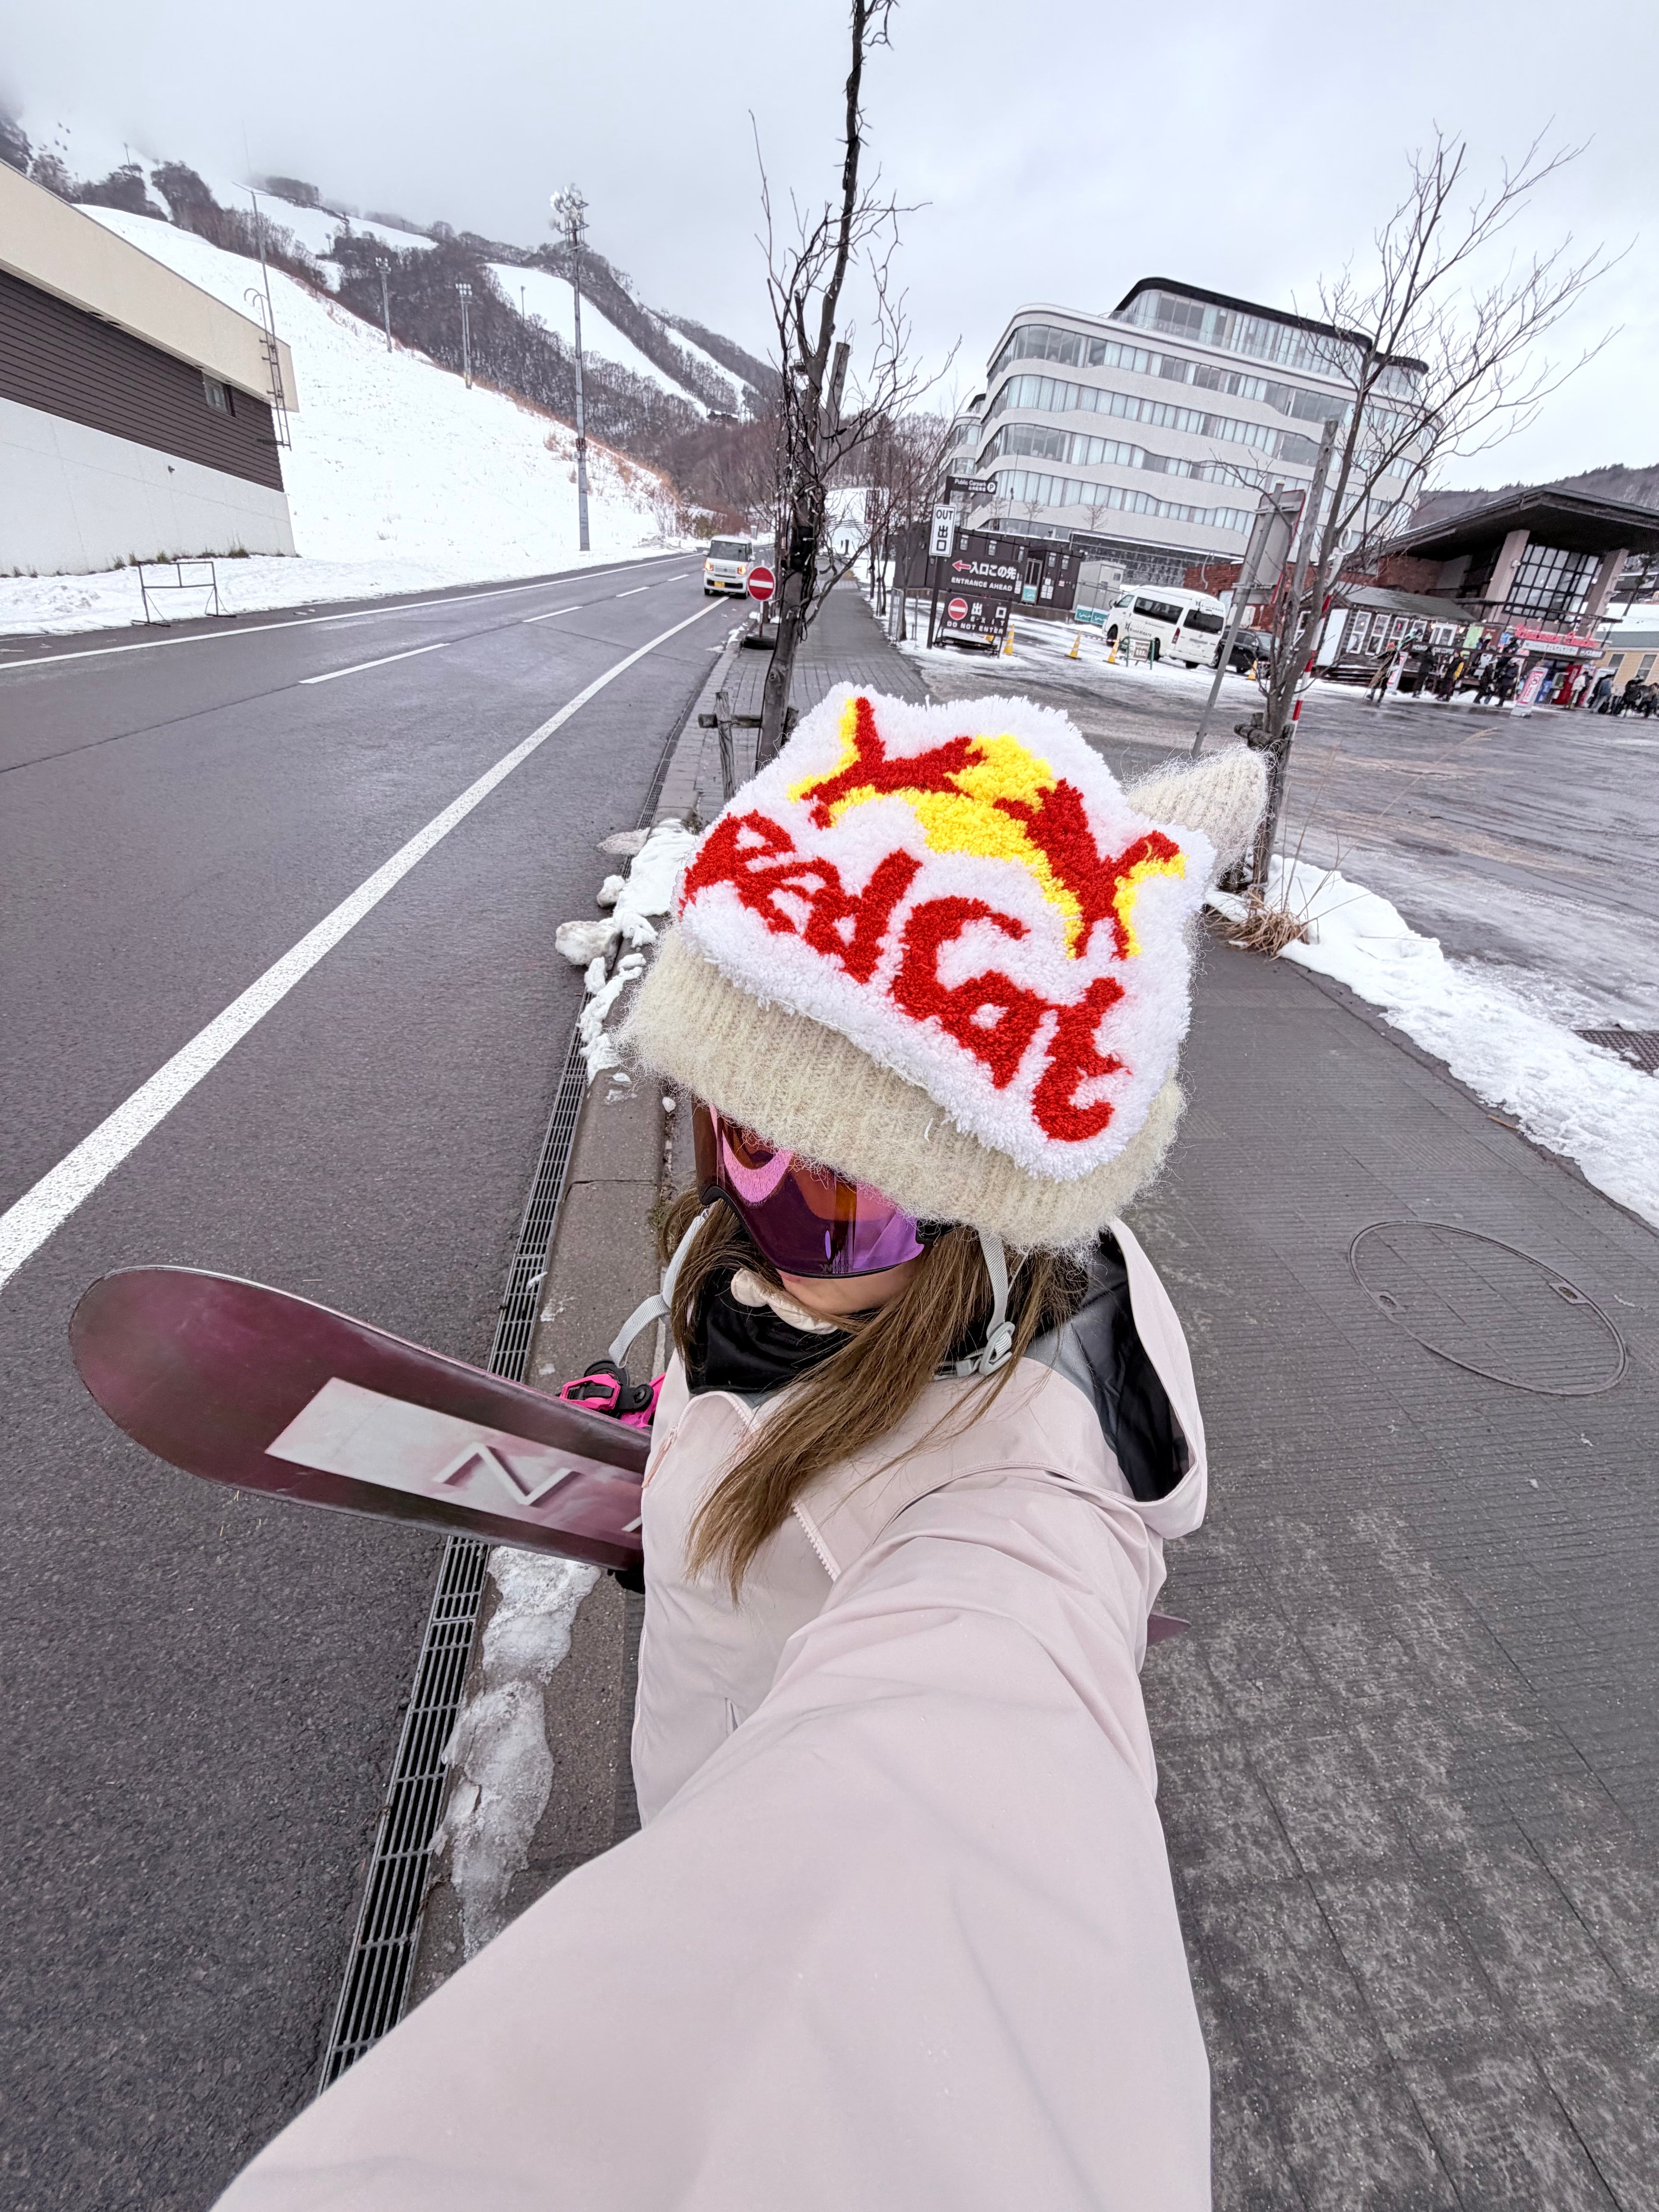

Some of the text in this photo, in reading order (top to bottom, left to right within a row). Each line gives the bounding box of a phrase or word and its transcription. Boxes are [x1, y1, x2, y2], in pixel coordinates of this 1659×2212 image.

[936, 509, 953, 520] OUT
[936, 525, 948, 551] 出口
[969, 561, 1017, 580] 入口この先
[951, 577, 1013, 591] ENTRANCE AHEAD
[971, 602, 1007, 619] 出口
[970, 616, 1005, 626] EXIT
[979, 625, 1003, 634] ENTER
